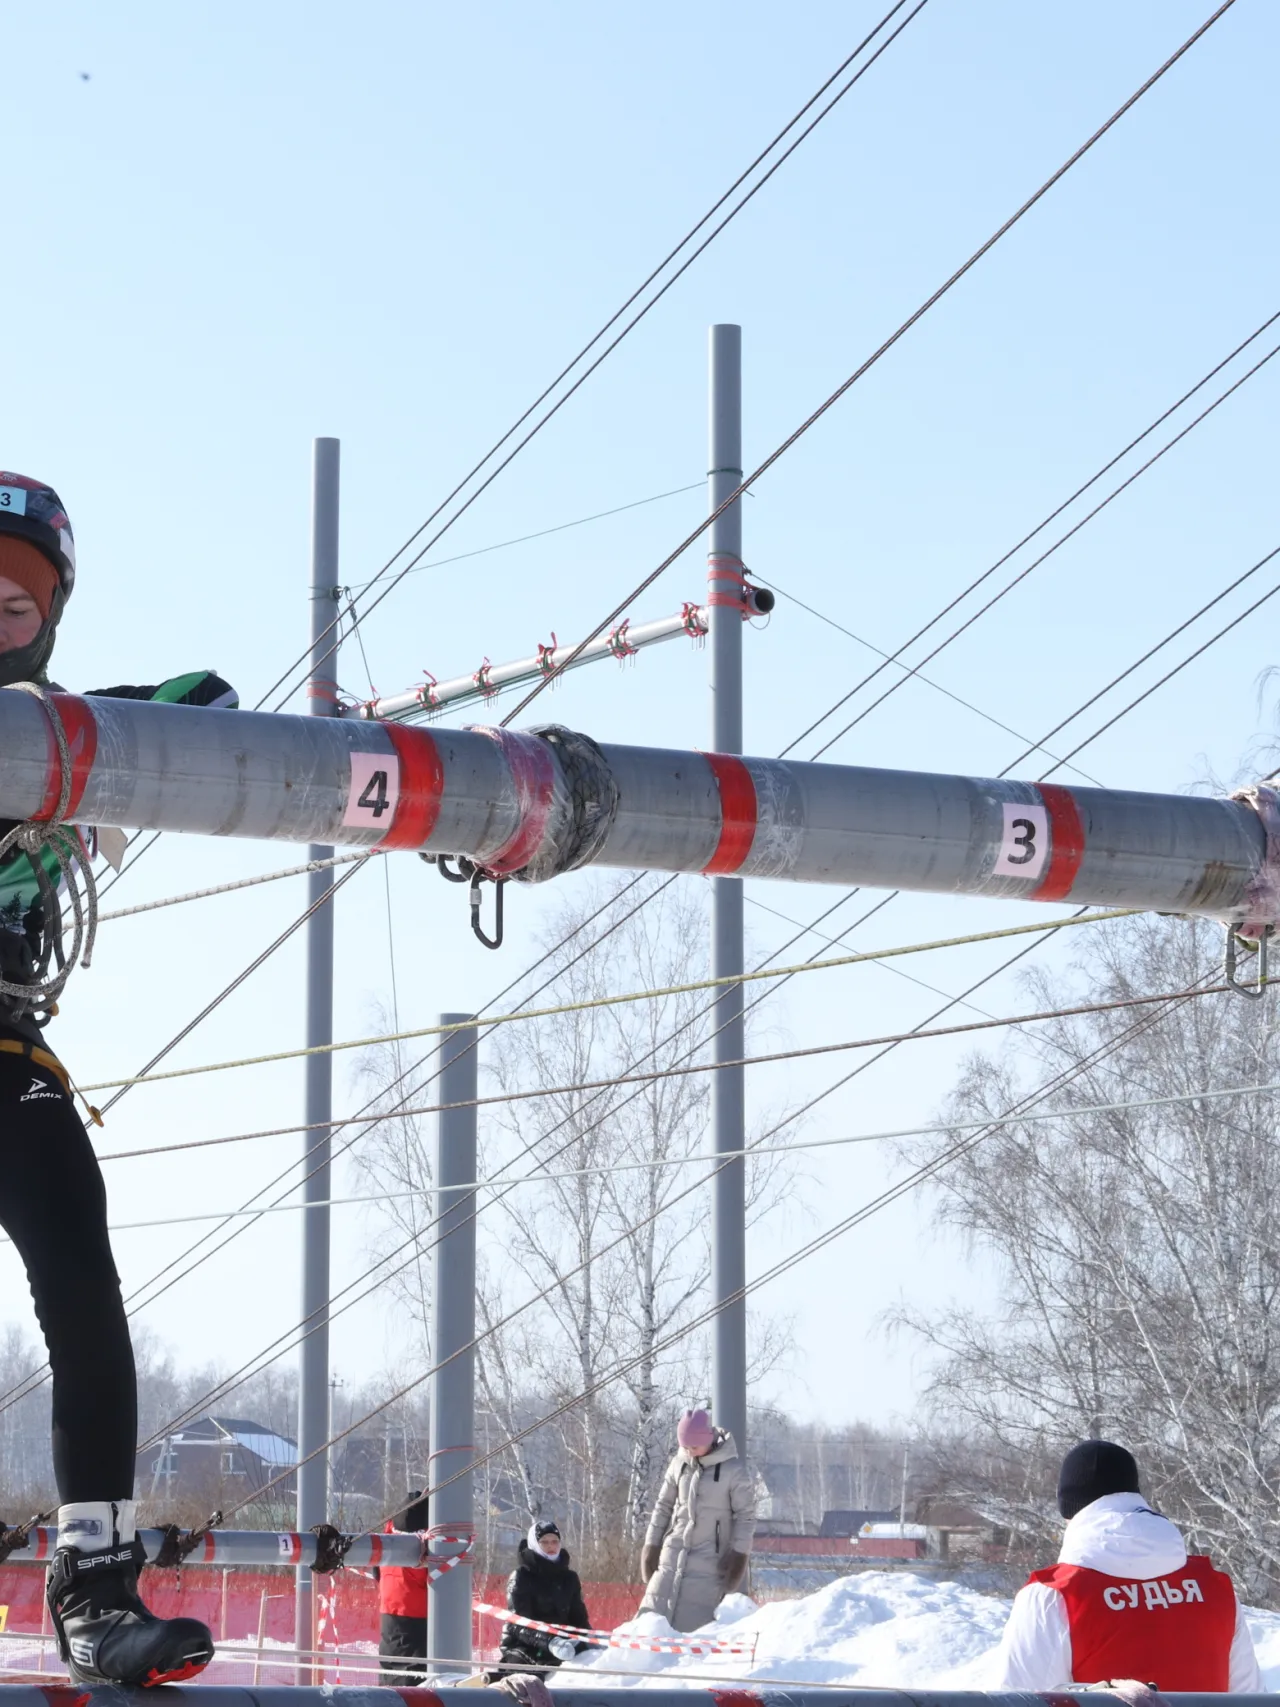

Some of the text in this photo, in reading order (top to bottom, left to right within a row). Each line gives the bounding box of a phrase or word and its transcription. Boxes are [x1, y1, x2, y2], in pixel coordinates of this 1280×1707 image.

[357, 770, 390, 818] 4
[1007, 818, 1036, 865] 3
[19, 1092, 63, 1102] DEMIX
[282, 1538, 290, 1551] 1
[76, 1549, 133, 1570] SPINE
[1103, 1579, 1204, 1611] СУДЬЯ
